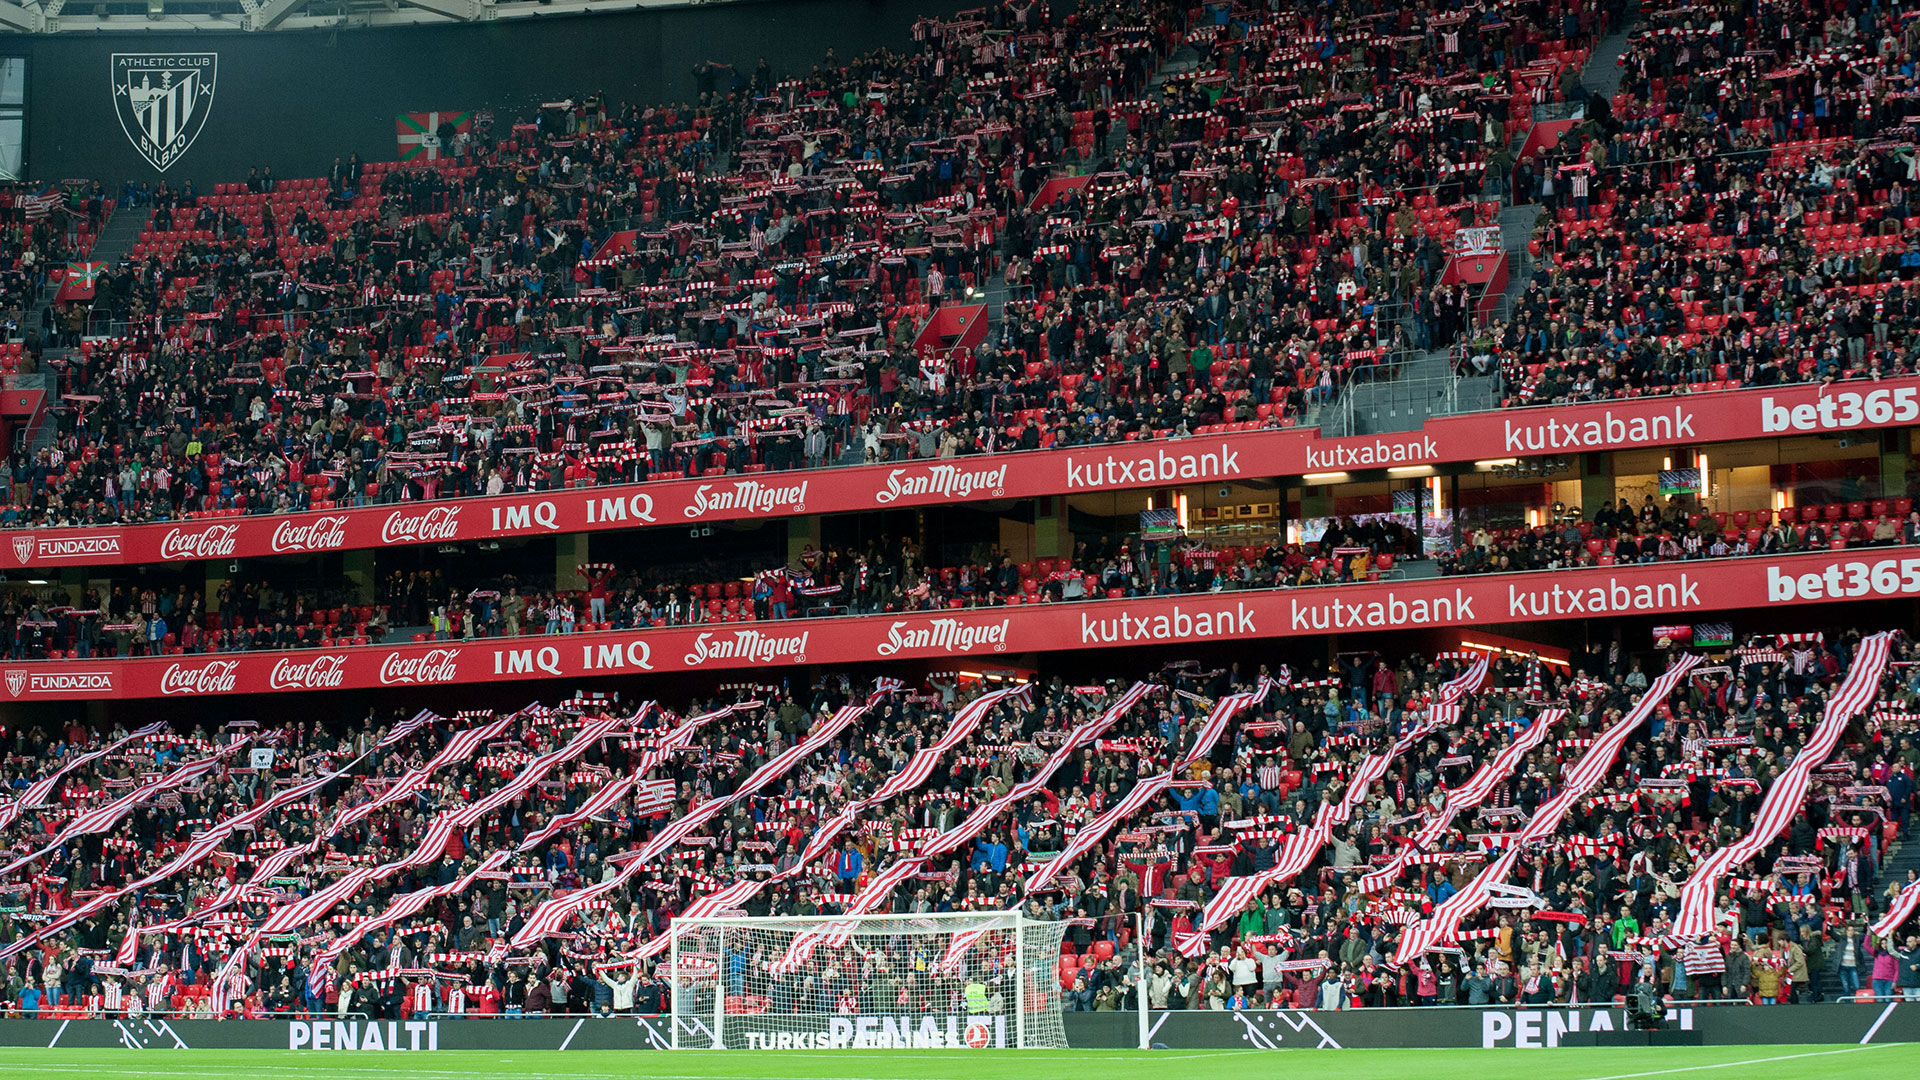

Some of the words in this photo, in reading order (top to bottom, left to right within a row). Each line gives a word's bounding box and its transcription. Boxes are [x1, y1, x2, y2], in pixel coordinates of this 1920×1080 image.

[119, 58, 175, 67] ATHLETIC
[178, 57, 210, 67] CLUB
[140, 133, 186, 167] BILBAO
[1761, 387, 1920, 433] bet365
[1504, 406, 1696, 452] kutxabank
[1067, 444, 1241, 488] kutxabank
[1306, 436, 1439, 469] kutxabank
[491, 501, 560, 531] IMQ
[586, 493, 657, 526] IMQ
[38, 538, 120, 556] FUNDAZIOA
[1509, 574, 1701, 617] kutxabank
[1767, 559, 1920, 602] bet365
[1081, 602, 1256, 644] kutxabank
[1291, 588, 1475, 631] kutxabank
[494, 646, 562, 675] IMQ
[583, 640, 653, 670] IMQ
[31, 675, 112, 690] FUNDAZIOA
[289, 1021, 438, 1051] PENALTI
[744, 1031, 847, 1049] TURKISH
[852, 1031, 960, 1049] AIRLINES
